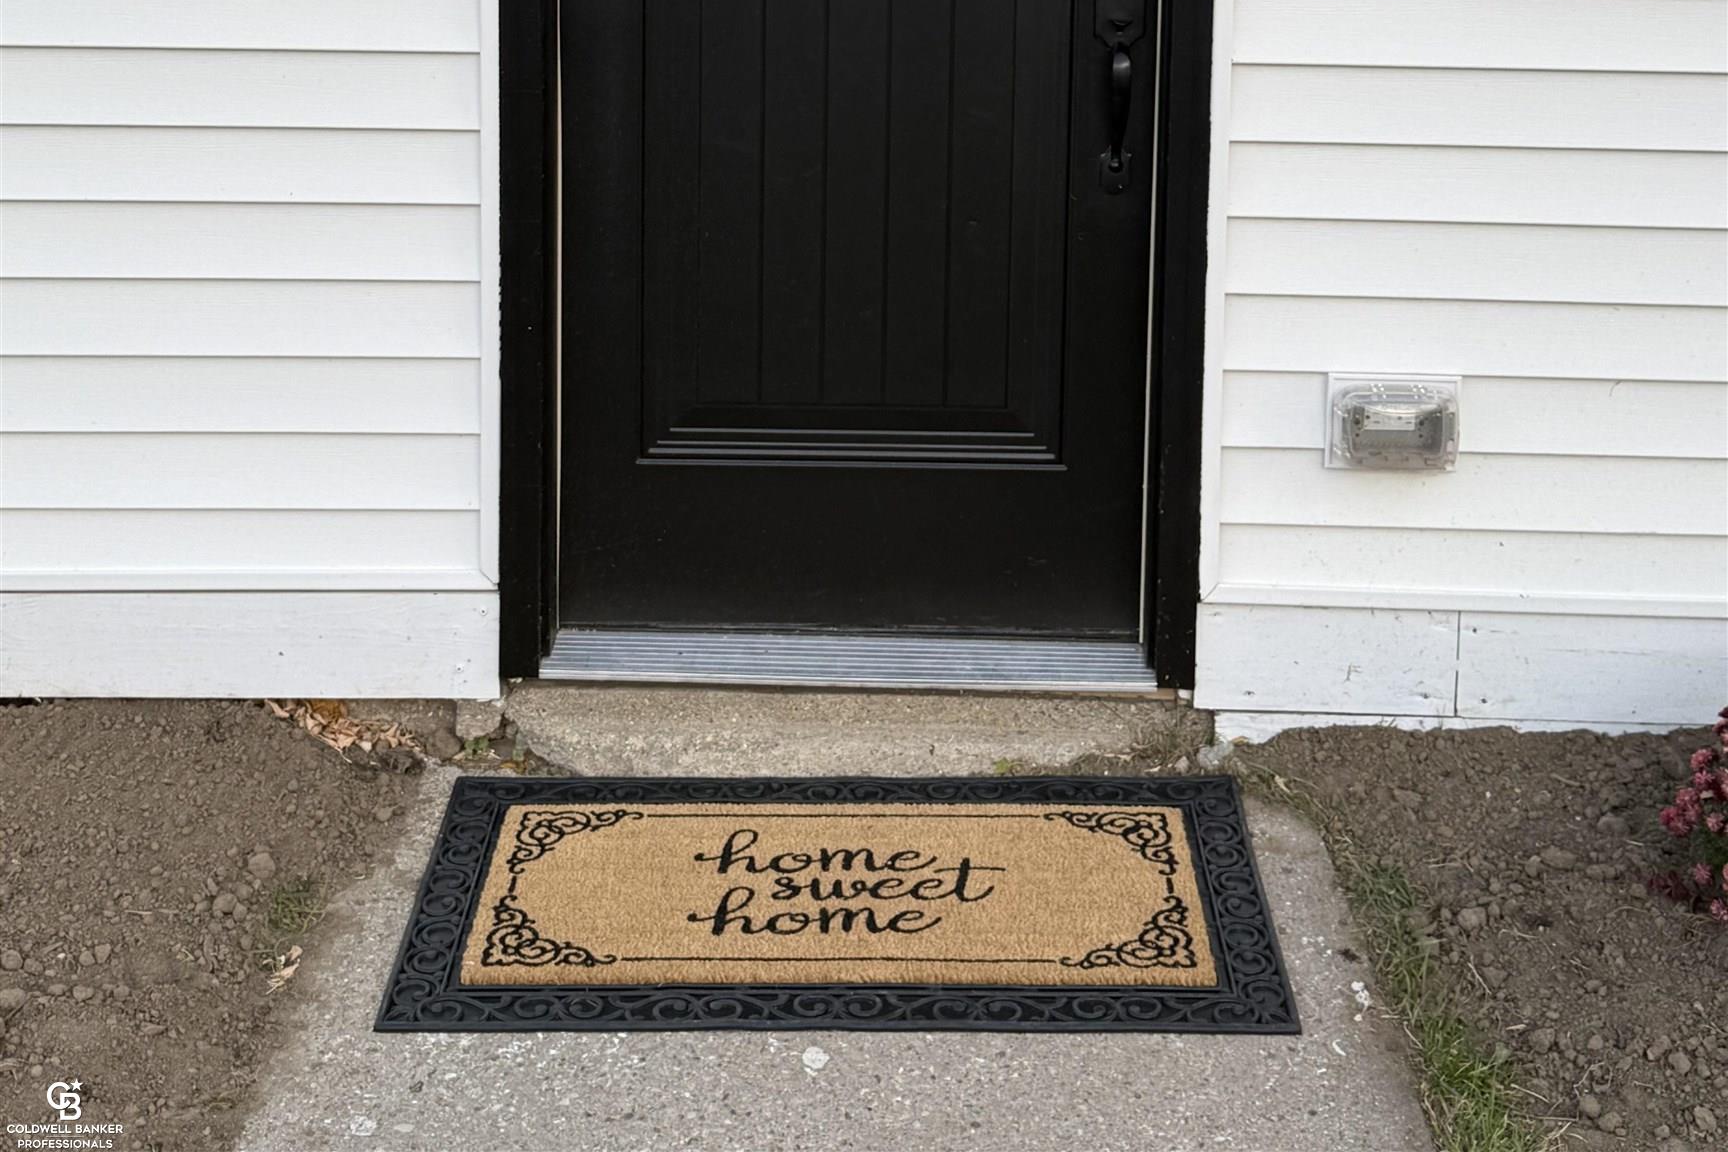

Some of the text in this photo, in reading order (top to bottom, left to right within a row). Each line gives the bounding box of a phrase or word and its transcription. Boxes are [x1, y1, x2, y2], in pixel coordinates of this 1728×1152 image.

[694, 829, 937, 874] home
[771, 857, 1006, 902] sweet
[687, 886, 942, 936] home
